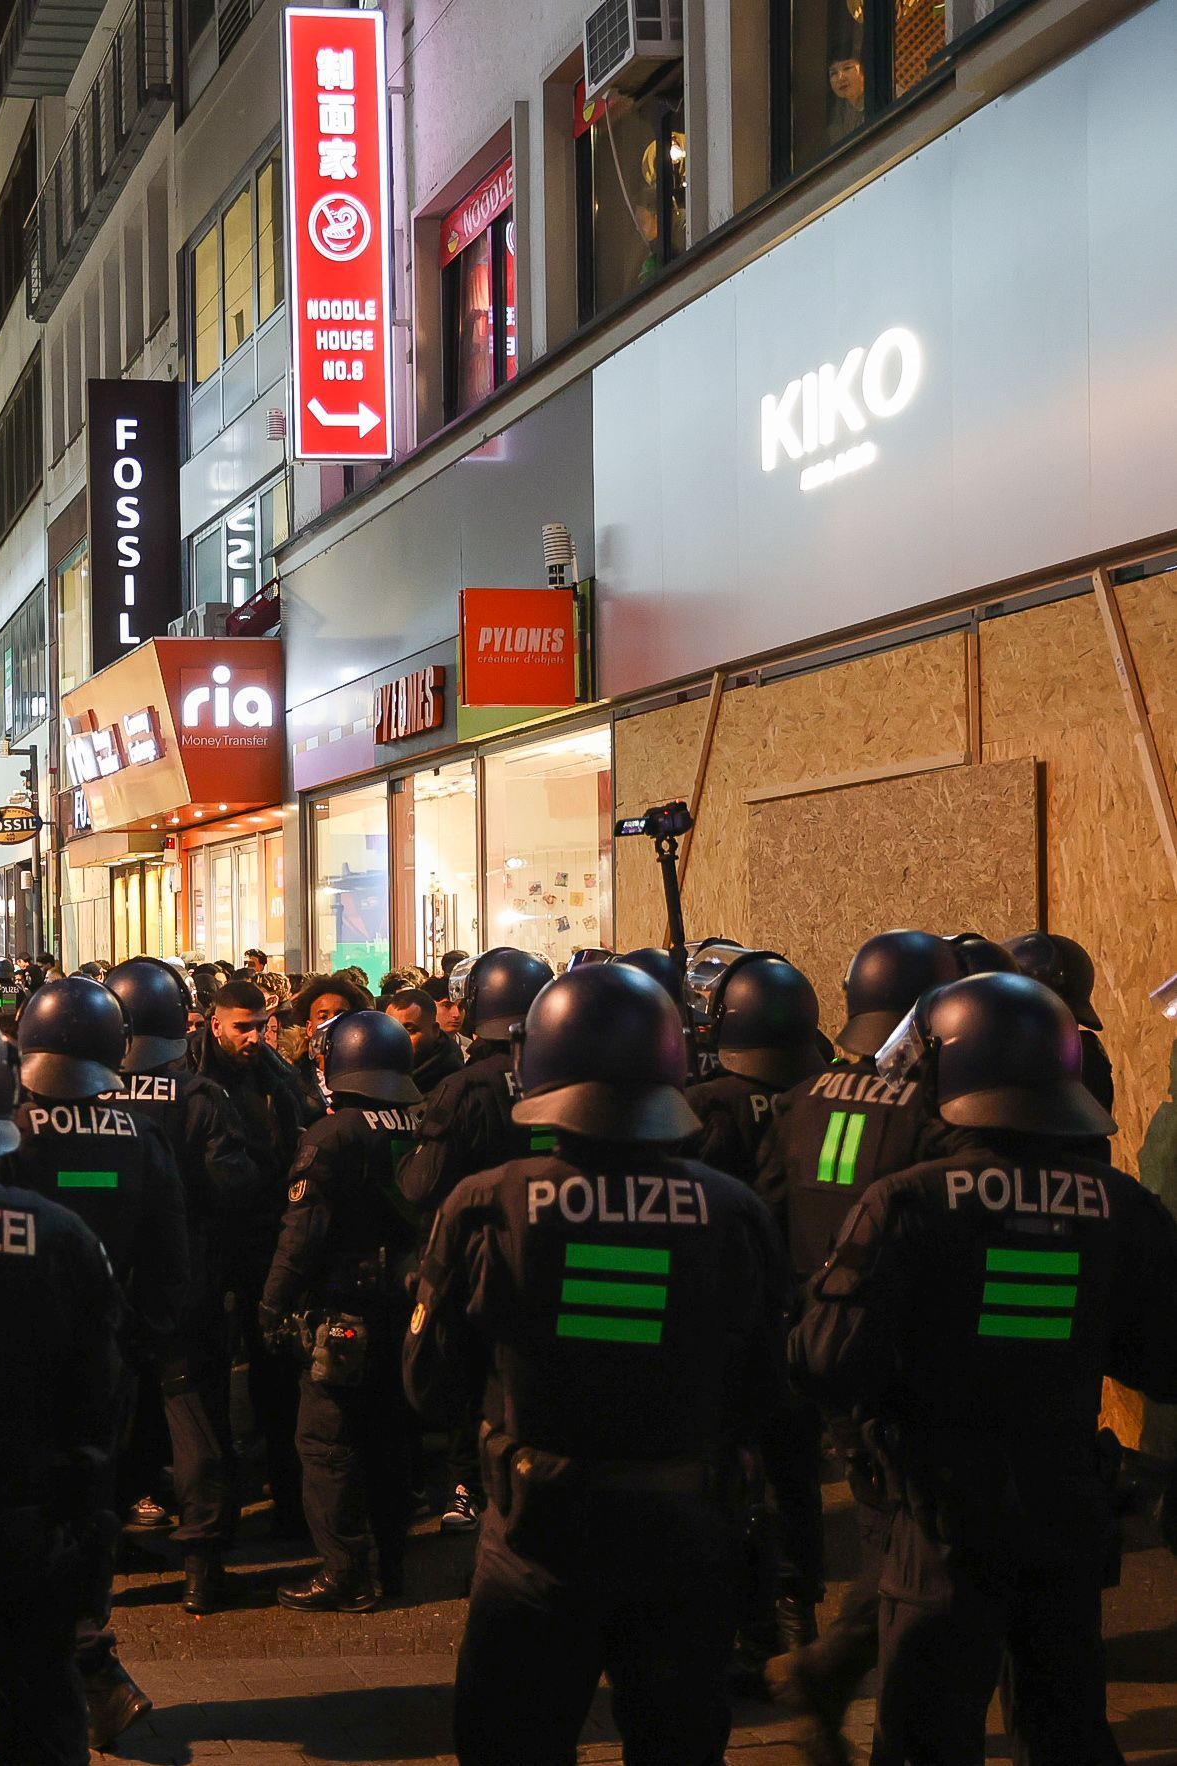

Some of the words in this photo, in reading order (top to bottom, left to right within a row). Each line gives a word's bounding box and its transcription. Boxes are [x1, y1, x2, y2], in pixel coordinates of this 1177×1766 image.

[463, 166, 514, 238] NOODLE
[307, 299, 376, 321] NOODLE
[316, 329, 374, 352] HOUSE
[322, 361, 364, 382] NO.8
[761, 327, 922, 472] KIKO
[113, 418, 143, 645] FOSSIL
[478, 627, 565, 653] PYLONES
[524, 653, 565, 666] d'objets
[182, 665, 273, 728] ria
[374, 665, 436, 745] PYLONES
[182, 734, 222, 749] Money
[222, 734, 268, 746] Transfer
[97, 1075, 176, 1101] IZEI
[29, 1106, 137, 1137] POLIZEI
[528, 1175, 709, 1226] POLIZEI
[945, 1167, 1110, 1219] POLIZEI
